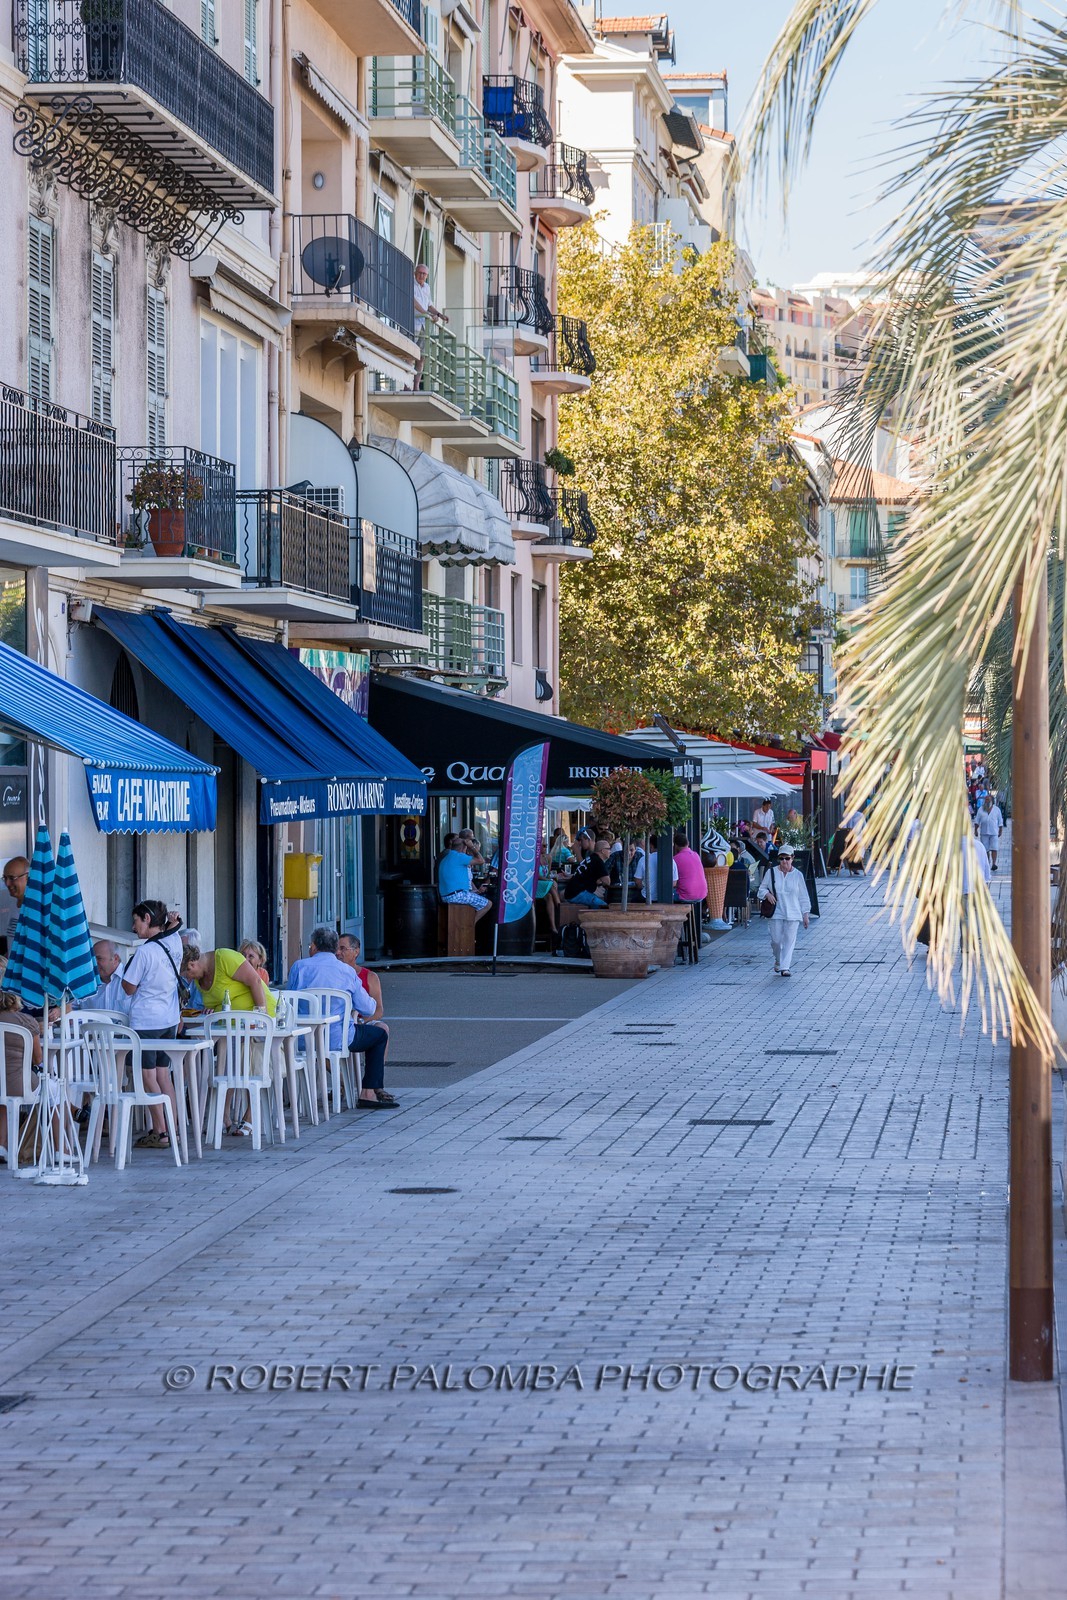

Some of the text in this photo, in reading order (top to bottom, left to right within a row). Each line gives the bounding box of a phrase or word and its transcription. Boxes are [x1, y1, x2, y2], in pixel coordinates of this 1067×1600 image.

[92, 774, 112, 794] SNACK
[446, 761, 506, 785] Qua
[568, 766, 610, 778] IRISH
[117, 778, 190, 822] CAFE MARITIME
[327, 782, 385, 811] ROMEO MARINE
[97, 801, 109, 820] BAR
[520, 774, 544, 863] Concierge
